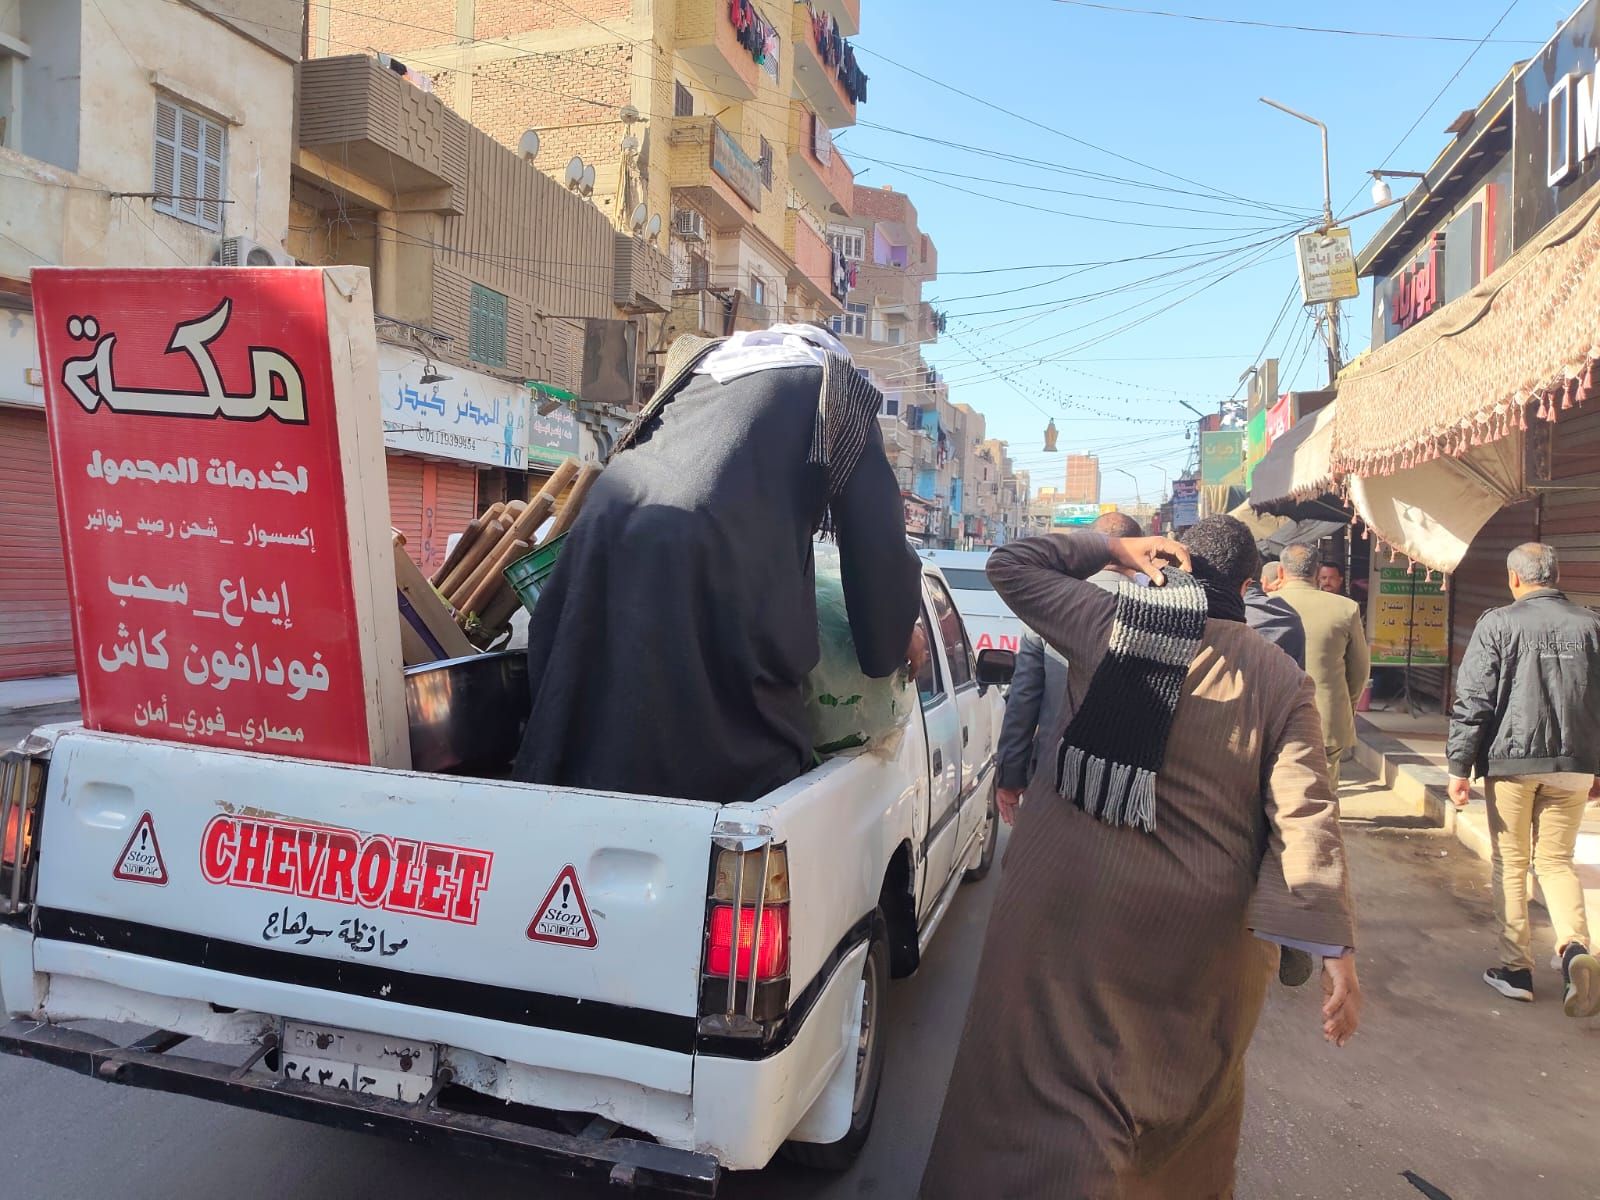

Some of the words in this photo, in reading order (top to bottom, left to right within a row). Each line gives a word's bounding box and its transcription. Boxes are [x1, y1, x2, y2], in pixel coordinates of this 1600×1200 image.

[61, 296, 309, 425] مكة
[86, 449, 200, 486] المحمول
[206, 459, 309, 496] لخدمات
[179, 516, 219, 541] شحن
[243, 523, 316, 554] إكسسوار
[97, 621, 170, 674] كاش
[182, 640, 331, 702] فودافون
[127, 850, 156, 866] Stop
[202, 815, 492, 923] CHEVROLET
[544, 907, 582, 926] Stop
[337, 917, 409, 957] محافظة
